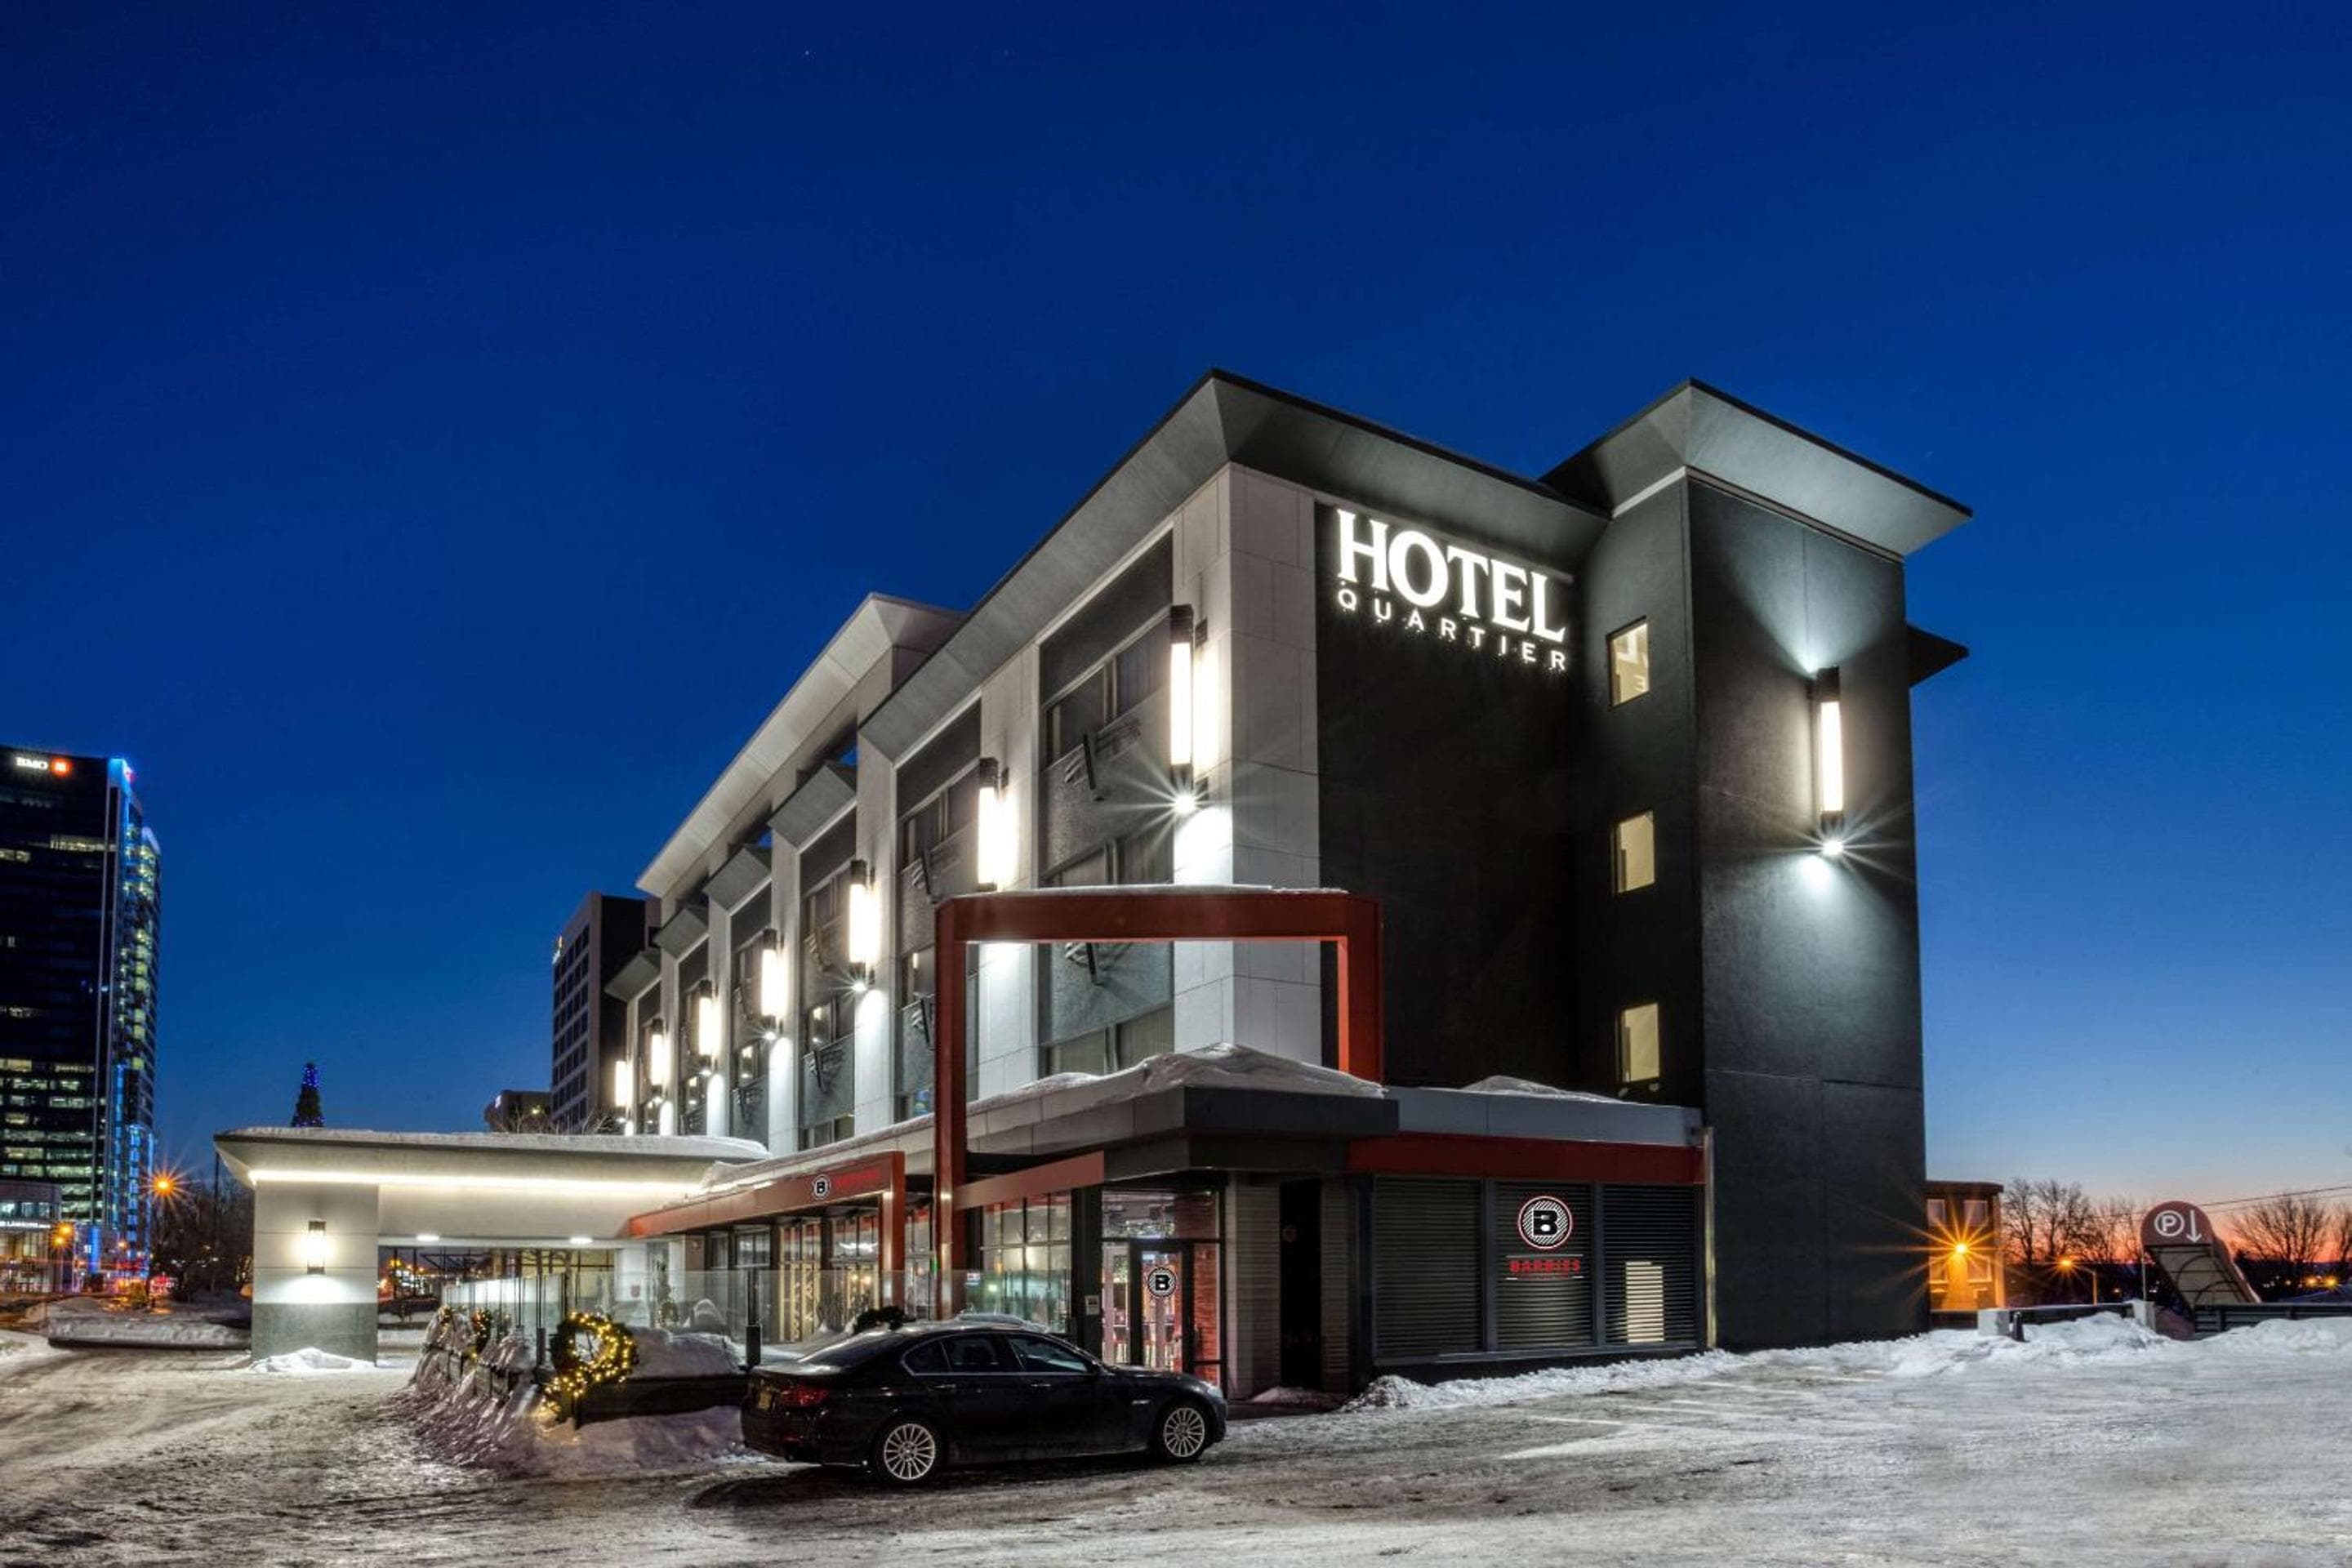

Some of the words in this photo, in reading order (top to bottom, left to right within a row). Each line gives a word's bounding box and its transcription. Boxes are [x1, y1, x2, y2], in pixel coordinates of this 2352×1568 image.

[1337, 508, 1566, 643] HOTEL
[1338, 588, 1566, 672] QUARTIER
[16, 757, 48, 770] BMO
[1533, 1209, 1558, 1236] B
[2161, 1215, 2177, 1232] P
